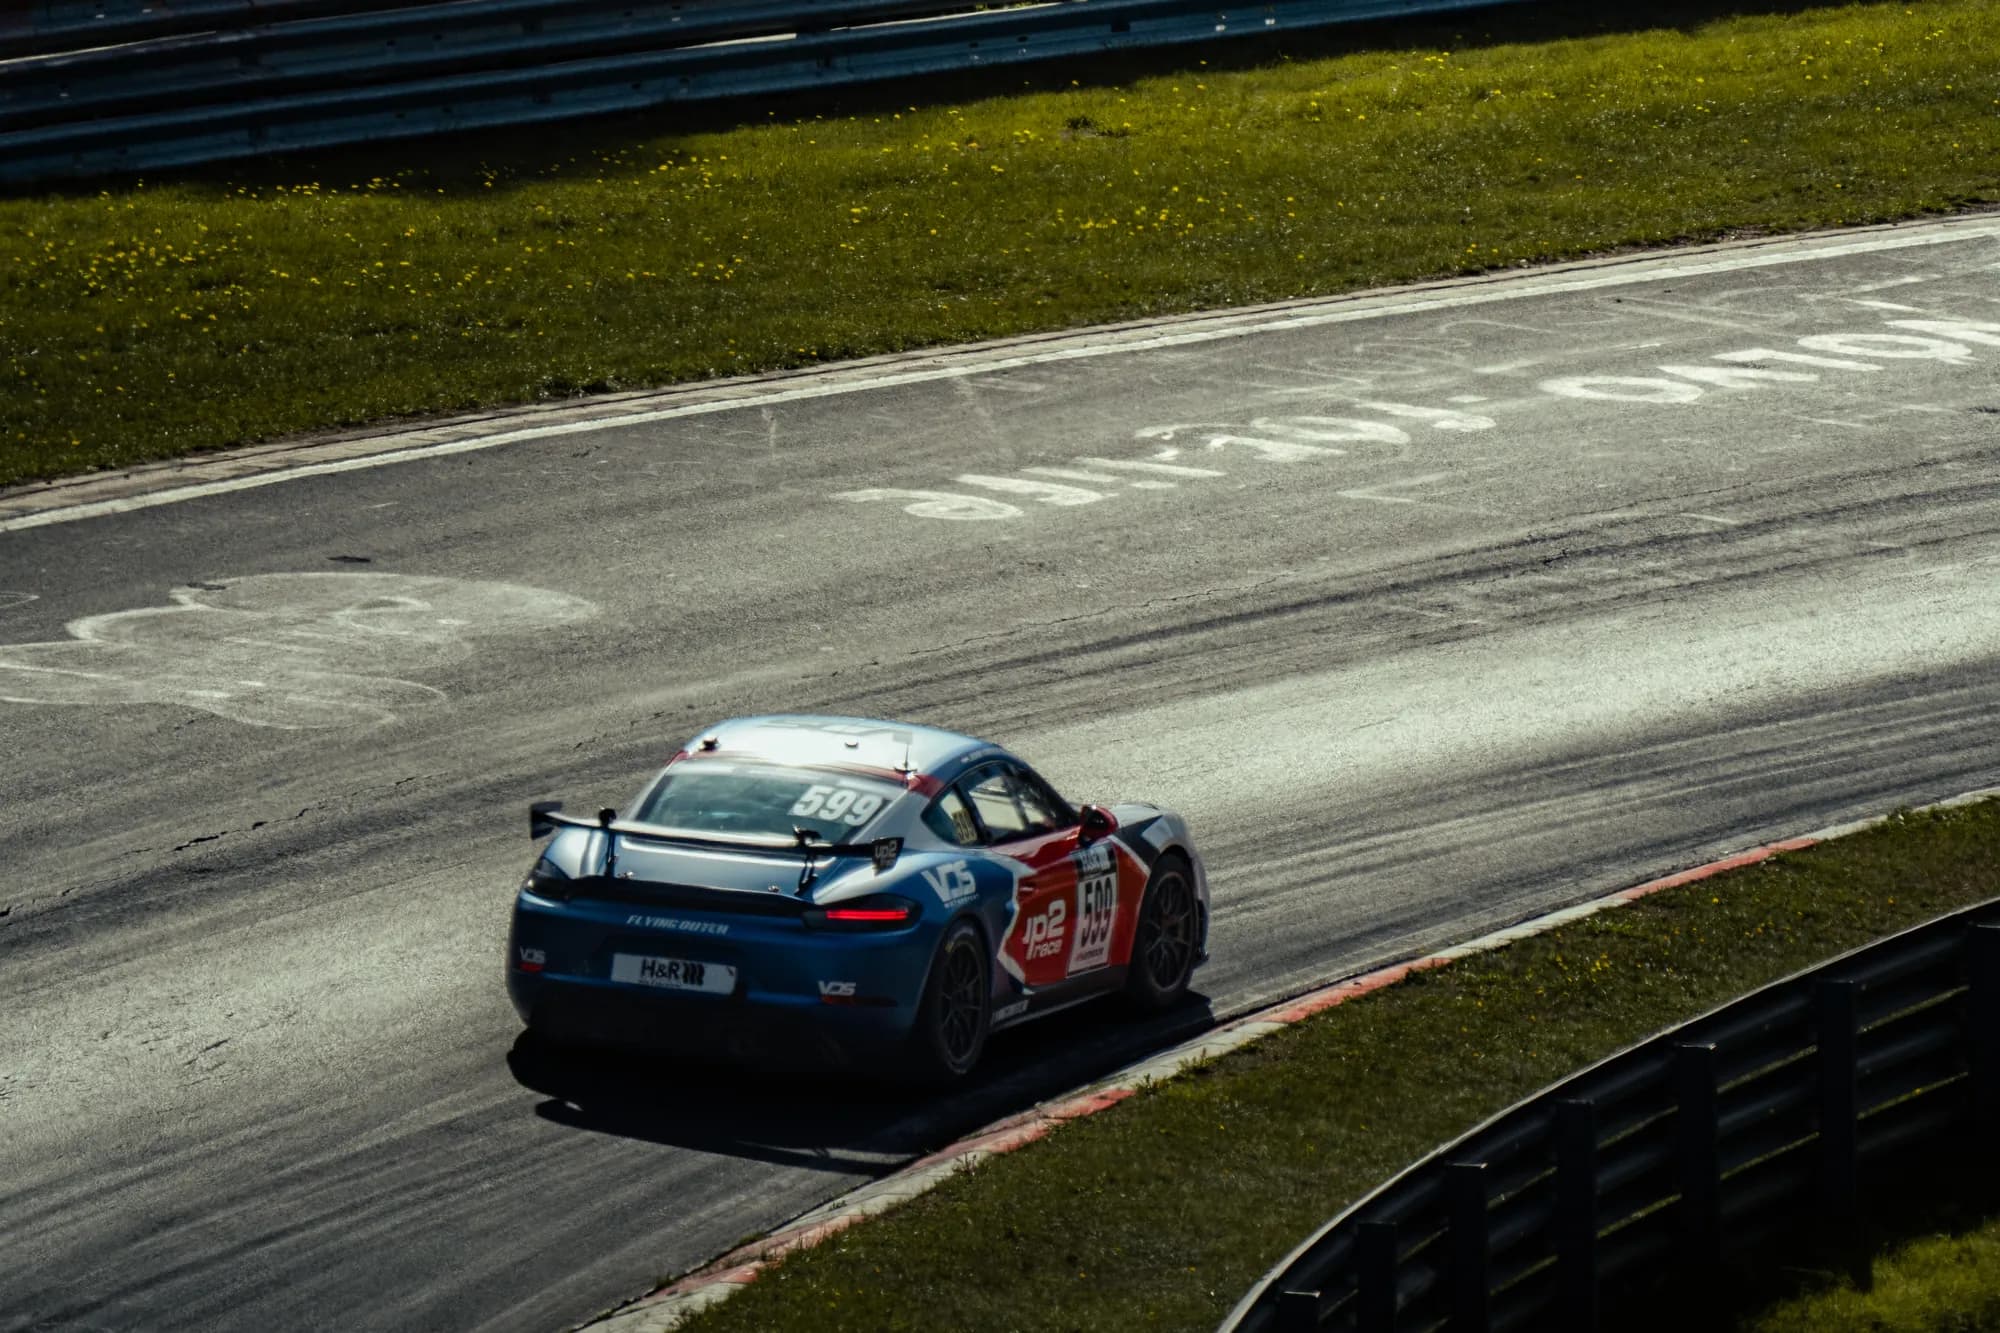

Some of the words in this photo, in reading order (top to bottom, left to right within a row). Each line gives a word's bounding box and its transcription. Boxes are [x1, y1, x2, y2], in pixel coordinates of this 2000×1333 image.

[794, 784, 882, 827] 599
[1081, 877, 1113, 948] 599
[625, 914, 680, 930] FLYING
[678, 919, 730, 936] DUTCH
[1033, 938, 1063, 959] race
[640, 958, 680, 981] H&R
